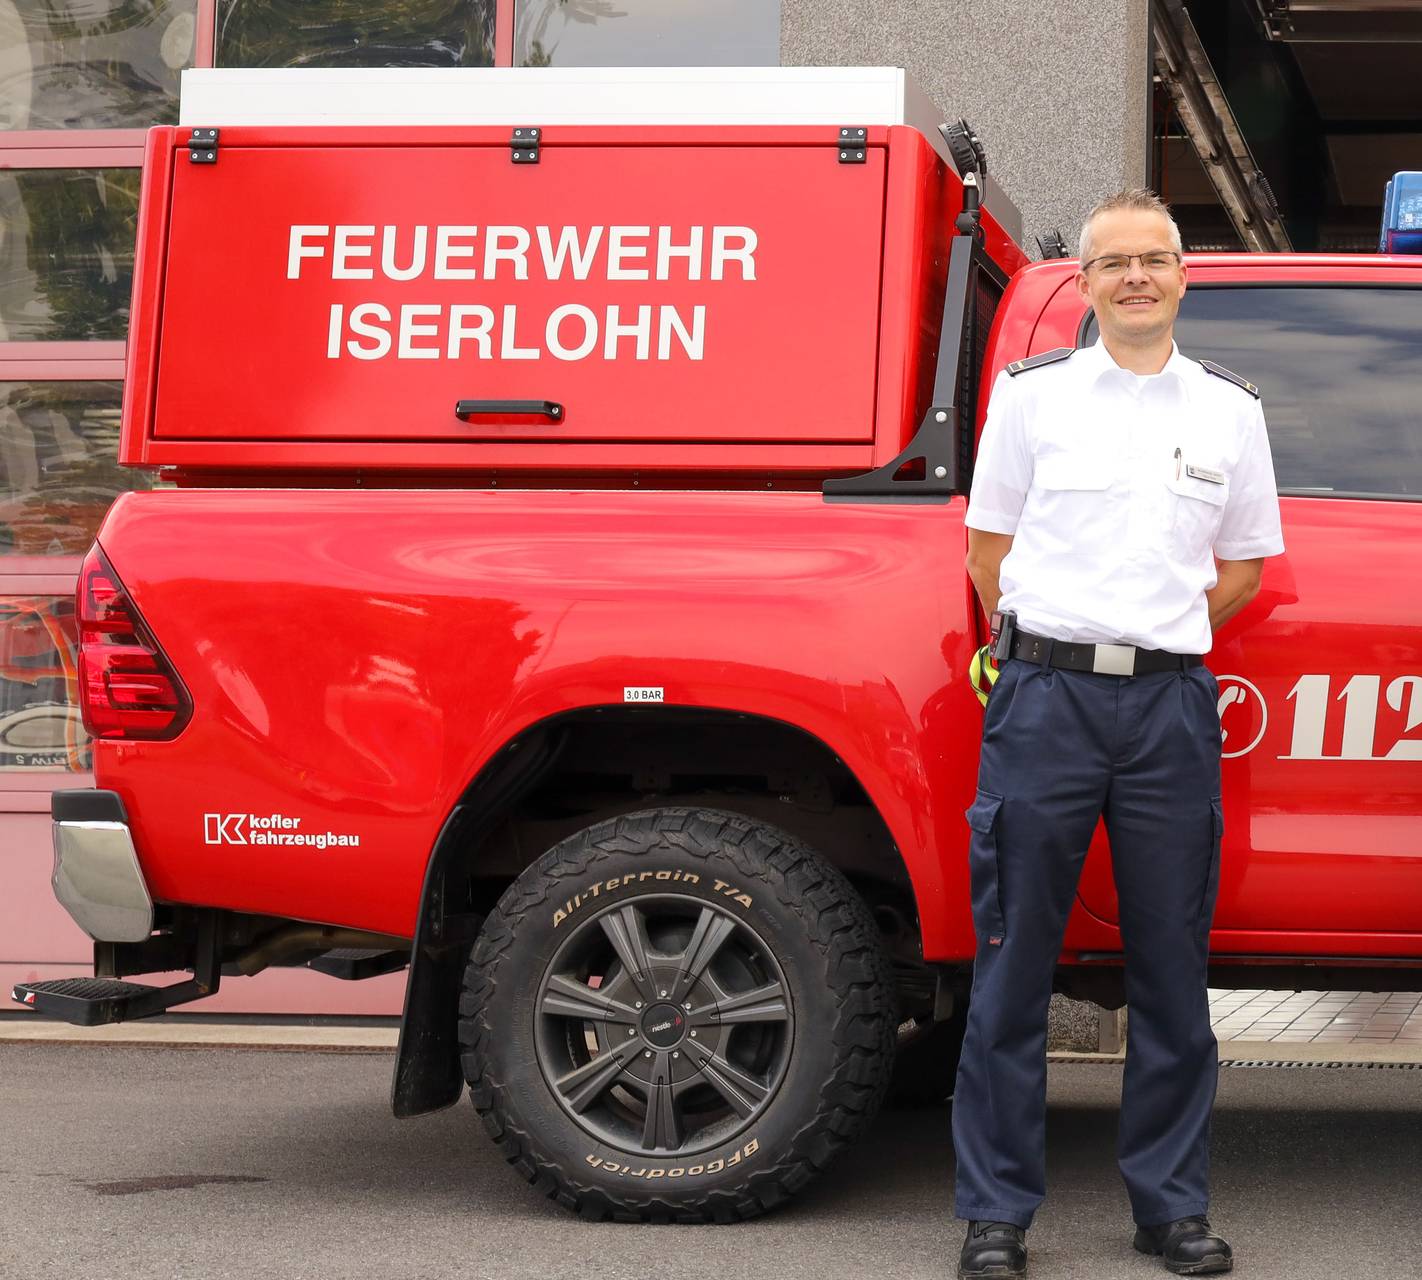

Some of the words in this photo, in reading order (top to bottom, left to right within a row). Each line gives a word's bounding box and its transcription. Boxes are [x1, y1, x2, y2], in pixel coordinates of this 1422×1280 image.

[287, 225, 758, 281] FEUERWEHR
[327, 302, 707, 361] ISERLOHN
[626, 690, 640, 700] 3,0
[641, 690, 661, 700] BAR
[249, 831, 359, 849] fahrzeugbau
[250, 814, 300, 829] kofler
[553, 870, 700, 928] All-Terrain
[713, 879, 753, 909] T/A
[585, 1138, 760, 1180] BFGoodrich
